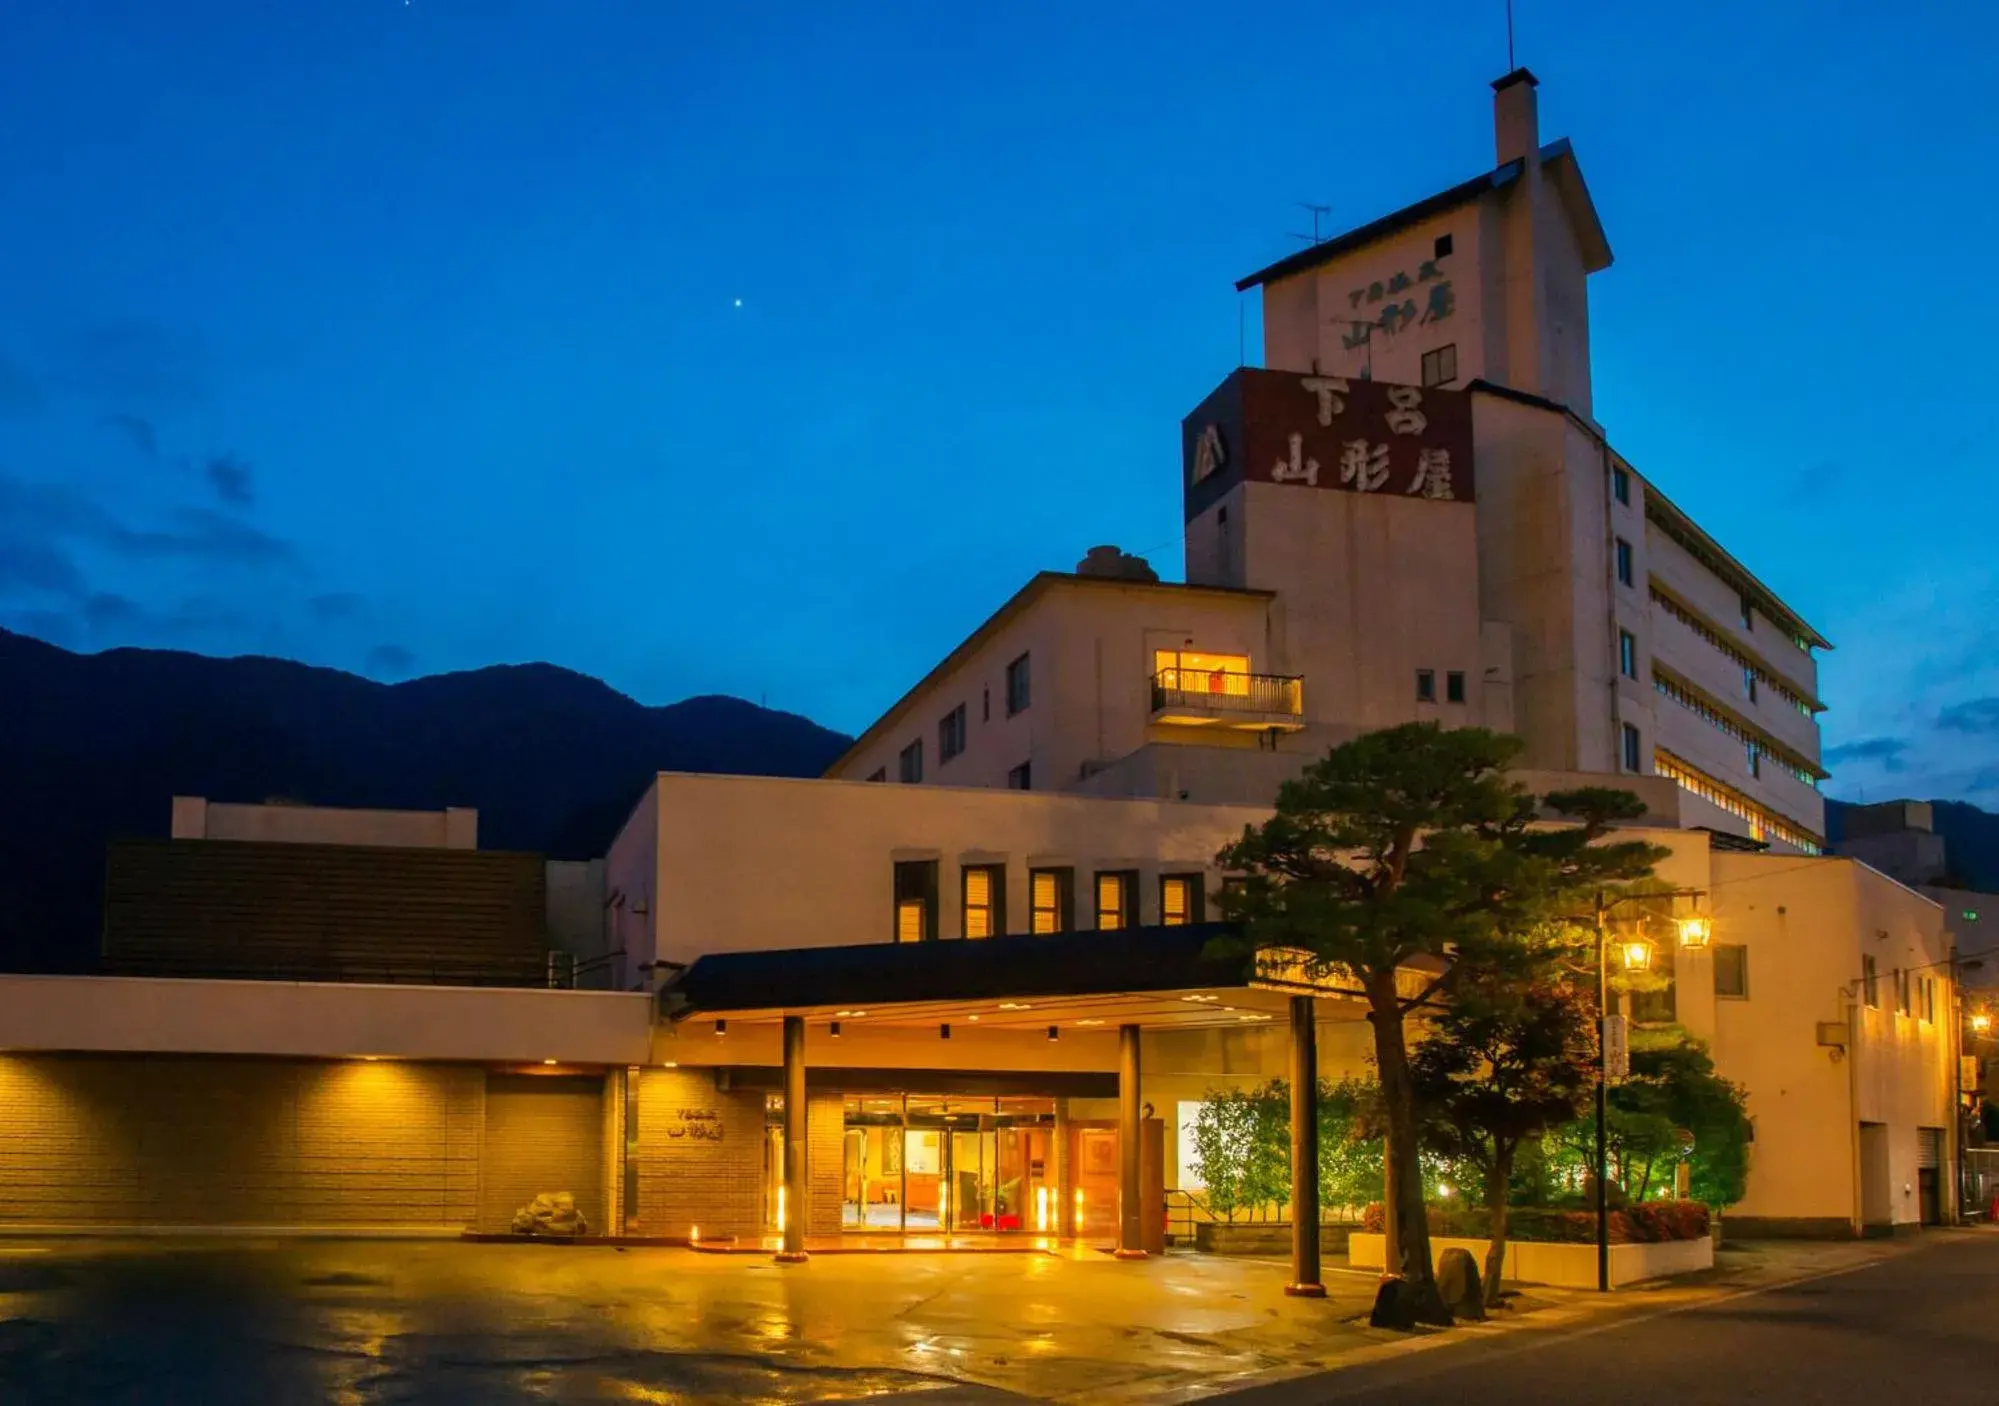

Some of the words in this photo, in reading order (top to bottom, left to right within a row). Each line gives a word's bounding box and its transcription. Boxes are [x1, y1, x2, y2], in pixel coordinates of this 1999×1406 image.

[1301, 377, 1428, 436] 下呂
[1271, 432, 1455, 499] 山形屋
